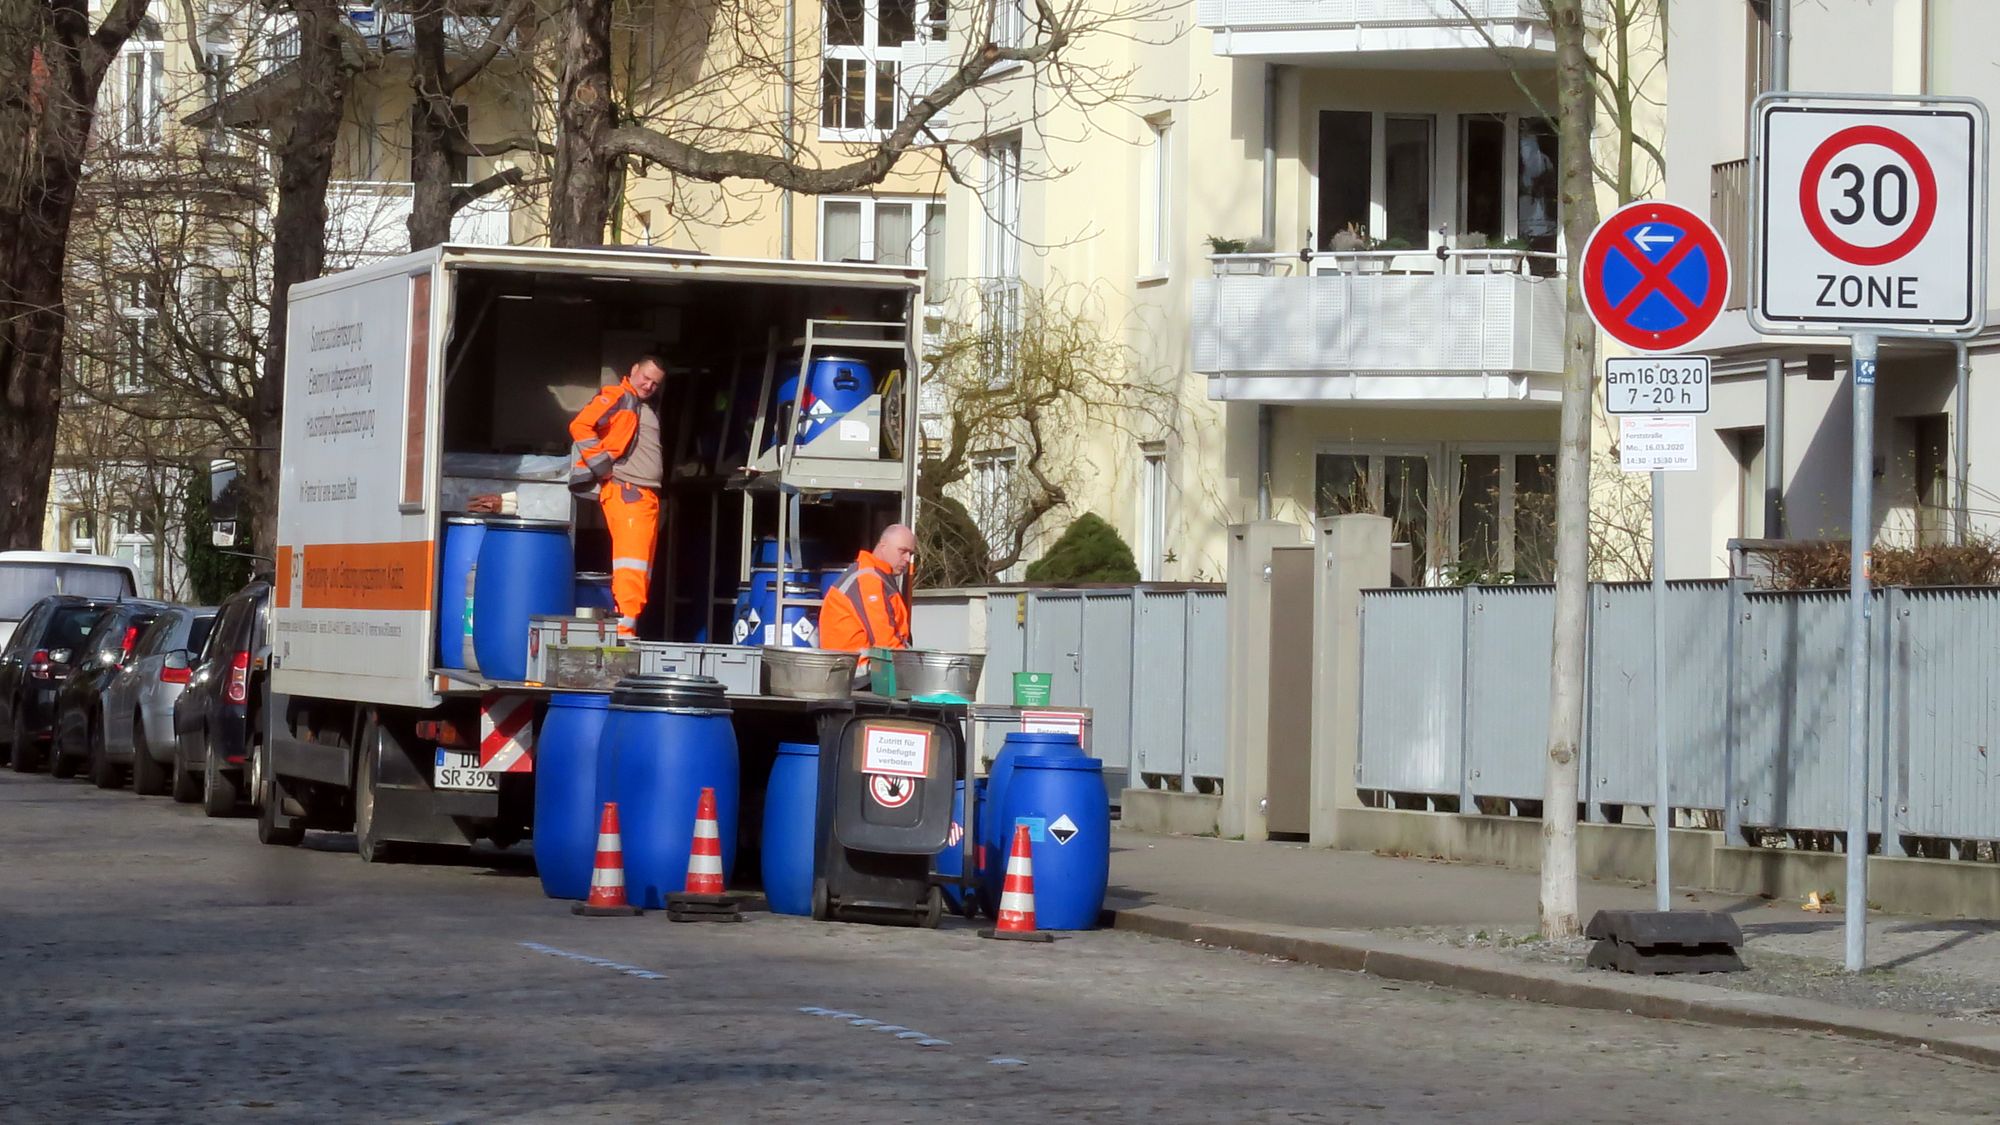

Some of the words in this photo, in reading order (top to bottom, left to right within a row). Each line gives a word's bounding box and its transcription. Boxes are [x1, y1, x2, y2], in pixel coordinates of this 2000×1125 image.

[1830, 163, 1907, 226] 30
[1816, 275, 1918, 308] ZONE
[1681, 388, 1691, 404] h
[1645, 443, 1685, 451] 16.03.2020
[878, 736, 903, 746] Zutritt
[904, 739, 916, 747] für
[876, 746, 917, 758] Unbefugte
[878, 757, 913, 767] verboten
[440, 769, 461, 785] SR
[466, 770, 496, 787] 396
